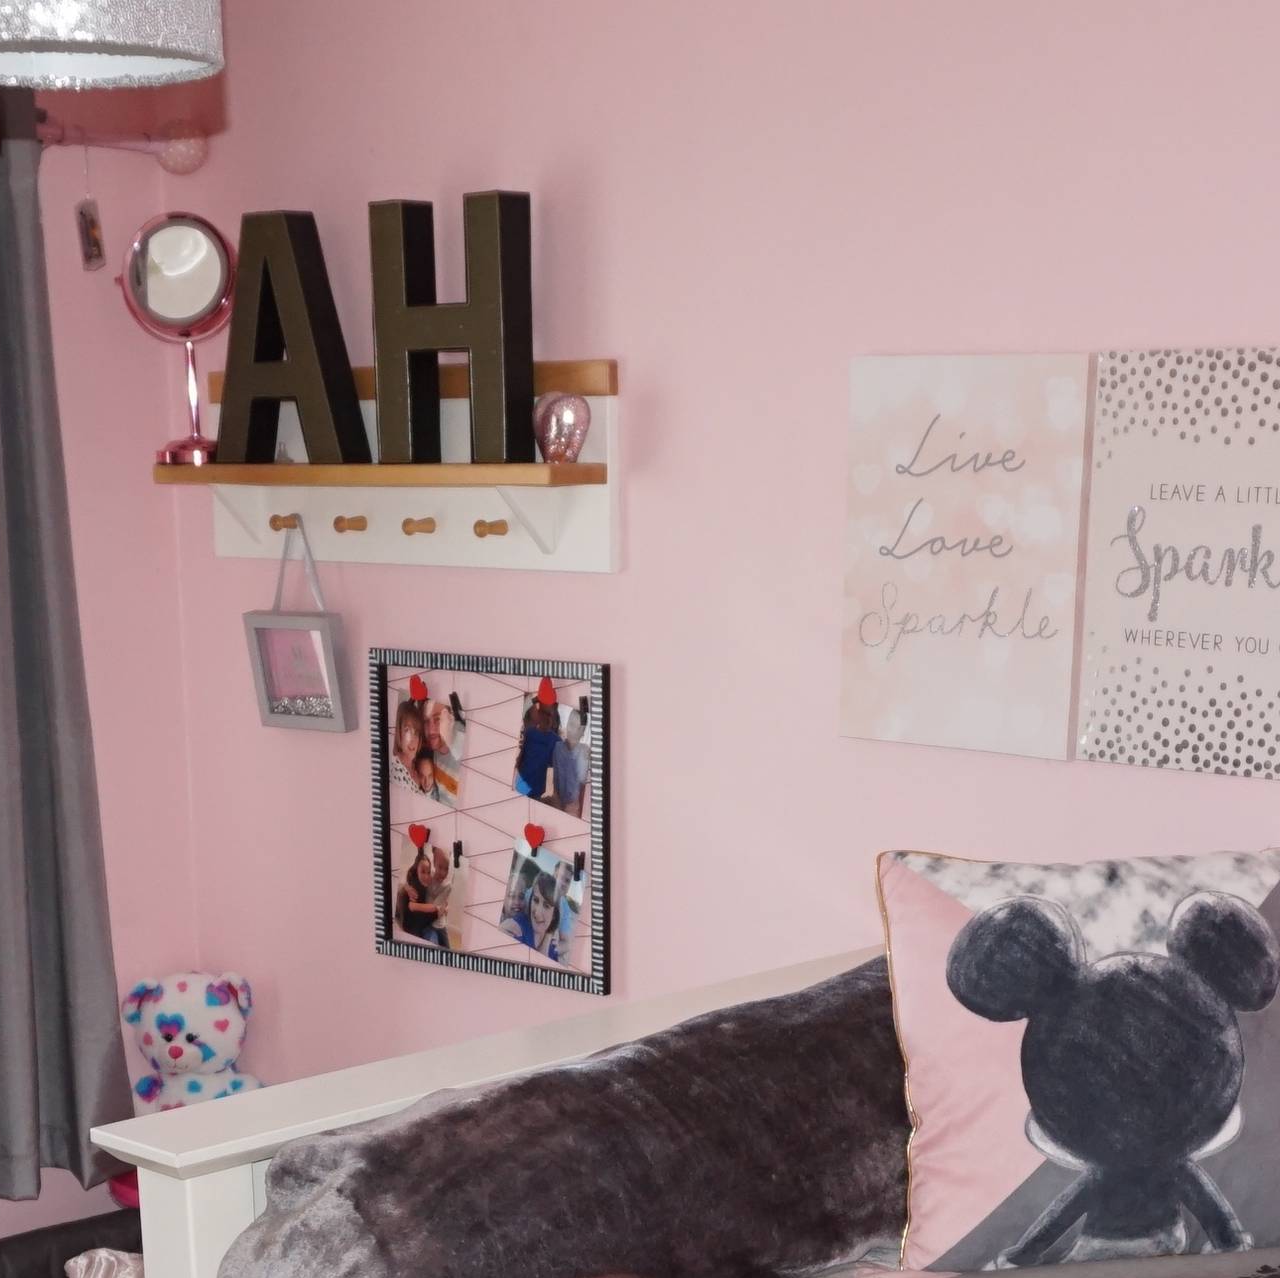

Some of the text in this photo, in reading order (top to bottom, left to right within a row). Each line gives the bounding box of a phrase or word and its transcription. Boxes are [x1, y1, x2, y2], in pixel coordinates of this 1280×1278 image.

[895, 413, 1026, 477] Live
[1149, 483, 1207, 502] LEAVE
[1214, 485, 1227, 503] A
[879, 498, 1014, 560] Love
[859, 581, 1059, 662] Sparkle
[1124, 628, 1223, 651] WHEREVER
[1235, 636, 1270, 655] YOU
